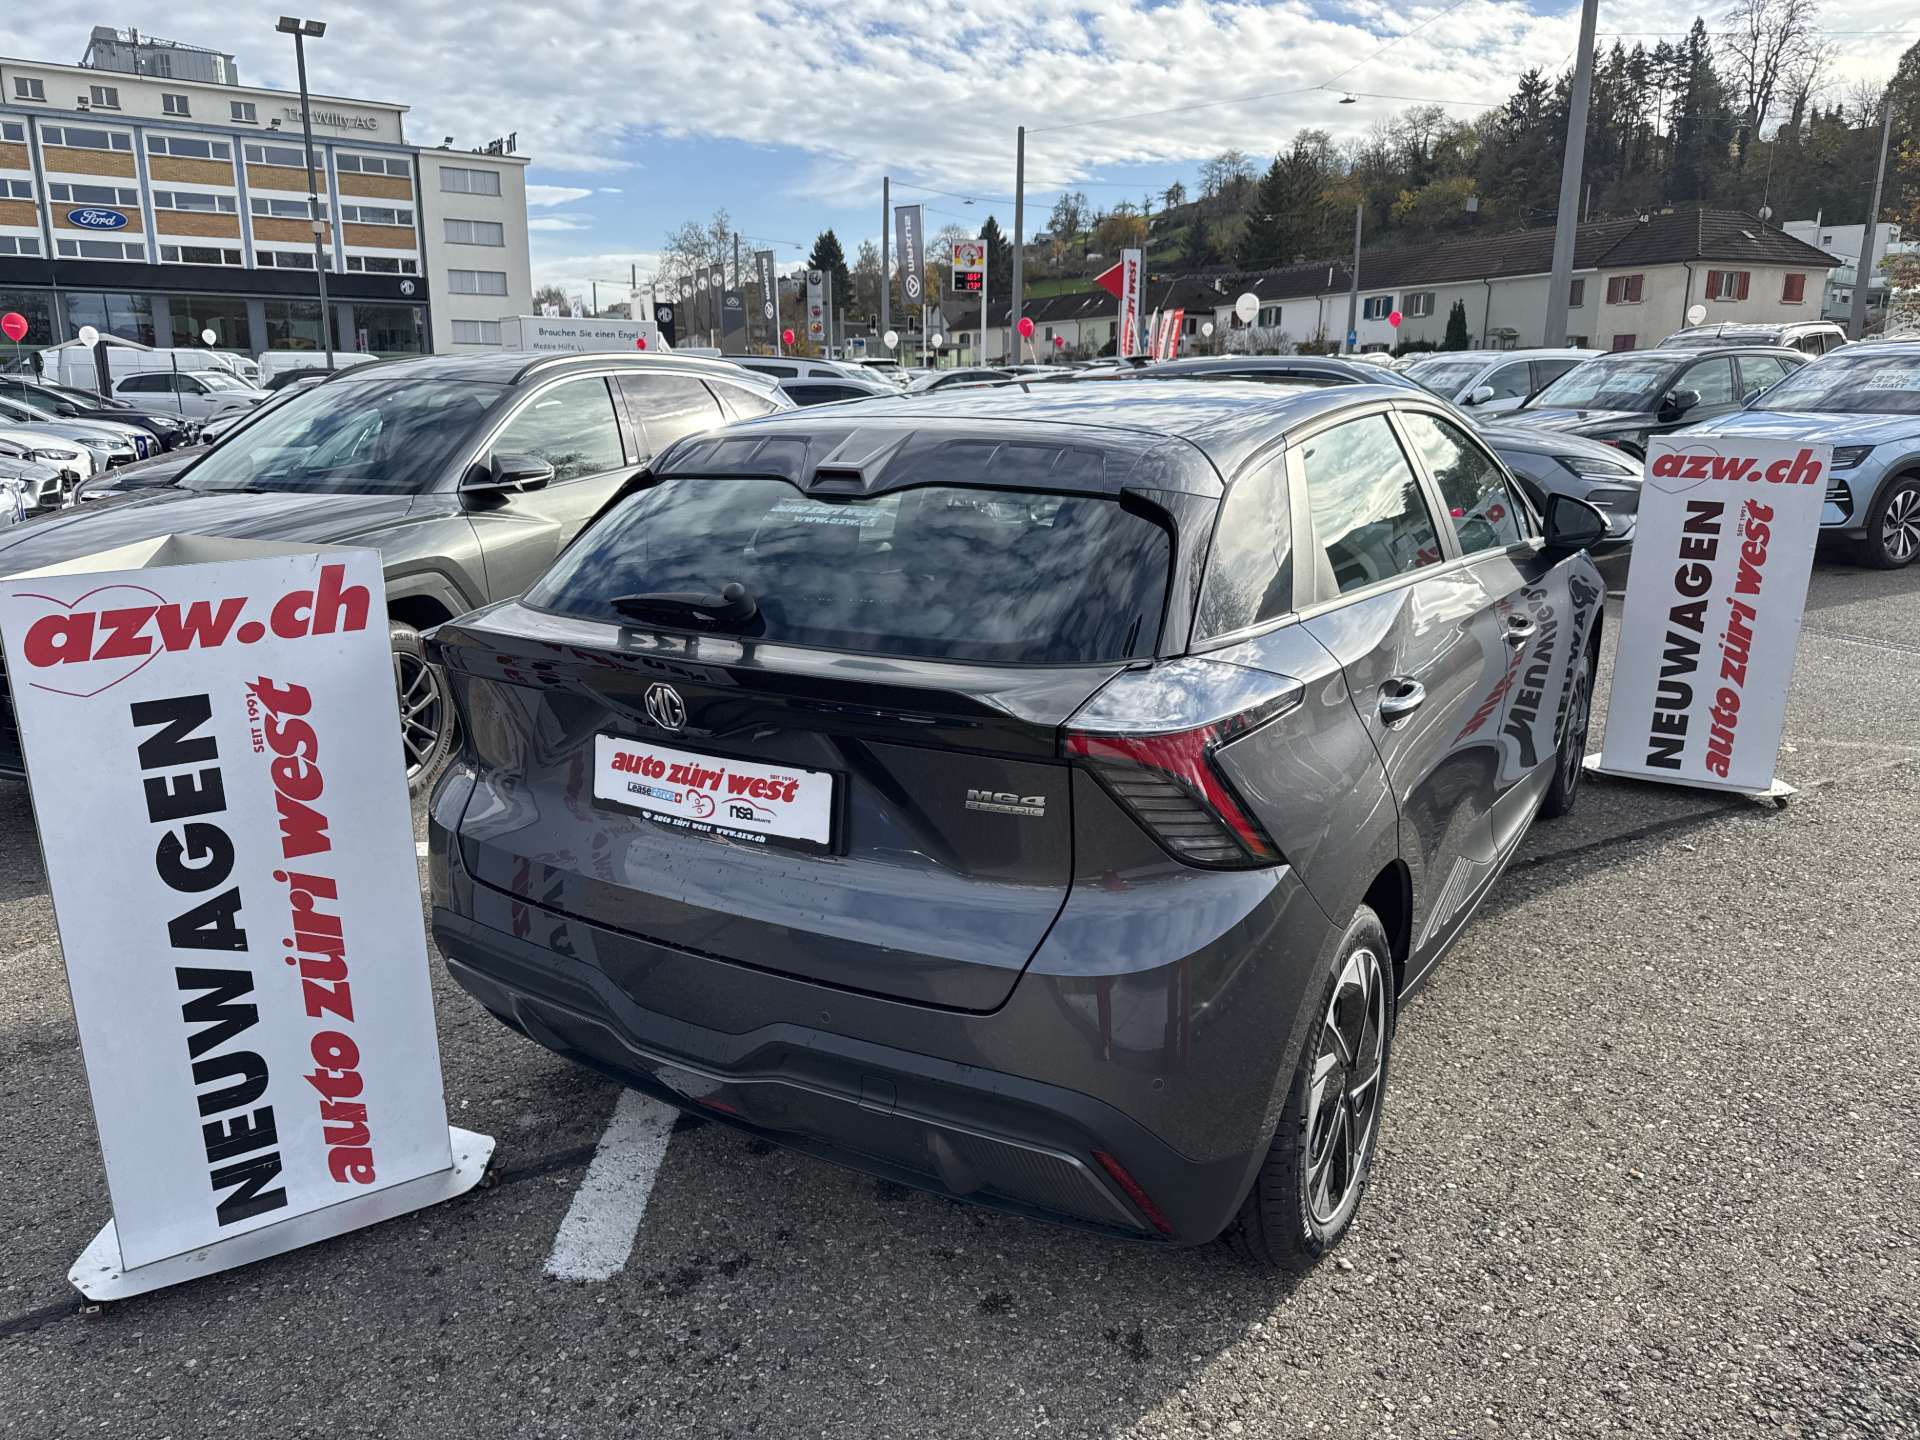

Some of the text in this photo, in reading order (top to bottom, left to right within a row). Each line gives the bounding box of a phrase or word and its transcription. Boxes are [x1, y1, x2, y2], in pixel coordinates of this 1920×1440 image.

[315, 111, 349, 130] Willy
[356, 114, 378, 130] AG
[80, 210, 117, 226] Ford
[539, 328, 576, 337] Brauchen
[580, 329, 592, 338] Sie
[595, 331, 616, 339] einen
[619, 331, 639, 341] Engel
[138, 440, 145, 457] P
[1652, 448, 1823, 485] azw.ch
[24, 564, 370, 667] azw.ch
[1645, 500, 1725, 770] NEUWAGEN
[1705, 499, 1774, 778] auto züri west
[246, 693, 264, 753] SEIT 1991
[649, 687, 683, 727] MG
[611, 752, 800, 803] auto züri west
[730, 805, 753, 820] nsa
[965, 801, 1045, 816] ELECTRIC
[967, 789, 1046, 806] MG4
[245, 676, 375, 1185] auto züri west
[130, 693, 288, 1227] NEUWAGEN
